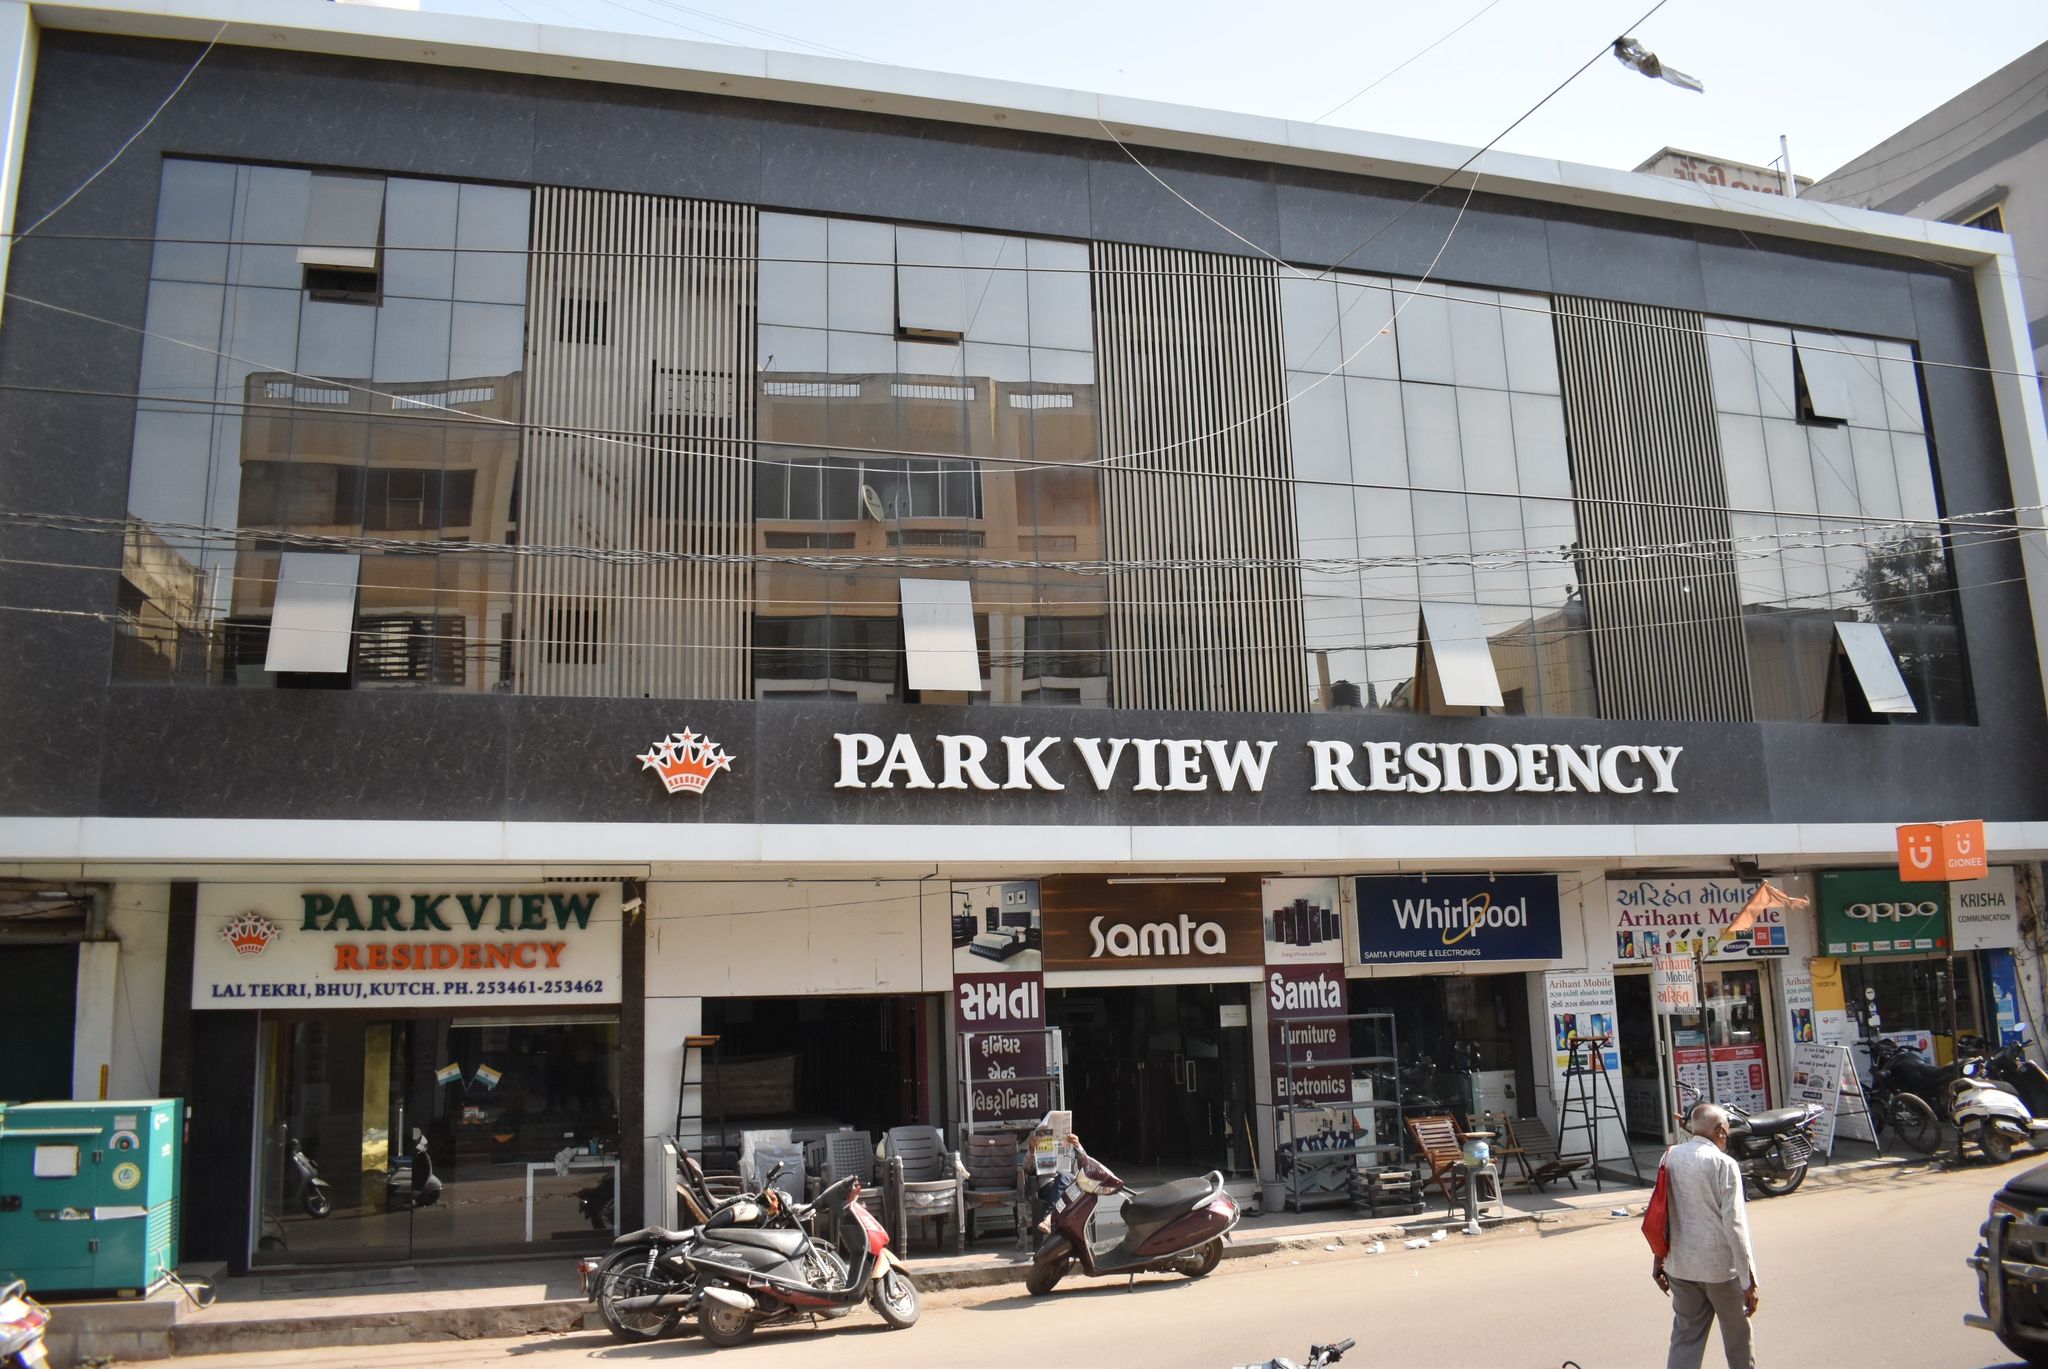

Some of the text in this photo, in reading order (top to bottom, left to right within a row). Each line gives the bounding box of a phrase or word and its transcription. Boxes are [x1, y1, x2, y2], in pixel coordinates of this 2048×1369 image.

[1307, 740, 1683, 793] RESIDENCY
[1948, 857, 1983, 868] GIONEE
[1616, 882, 1691, 907] અરિહંત
[1960, 892, 2006, 909] KRISHA
[1392, 897, 1527, 937] Whirlpool
[1617, 908, 1780, 927] Arihant Mole
[1846, 901, 1939, 923] oppo
[1957, 913, 2011, 924] COMMUNICATION
[1089, 914, 1226, 958] Samta
[333, 942, 566, 971] RESIDENCY
[1364, 949, 1481, 959] SAMTA FURNITURE & ELECTRONICS
[1654, 955, 1691, 971] Arihant
[1550, 978, 1612, 989] Arihant Mobile
[1666, 971, 1692, 983] Mobile
[1785, 978, 1810, 987] Arihan
[314, 982, 367, 999] BHUJ,
[370, 982, 440, 996] KUTCH.
[443, 982, 473, 995] PH.
[476, 980, 603, 995] 253461-253462
[1270, 972, 1341, 1010] Samta
[960, 982, 1039, 1020] સમતા
[1277, 1075, 1346, 1097] Electronics
